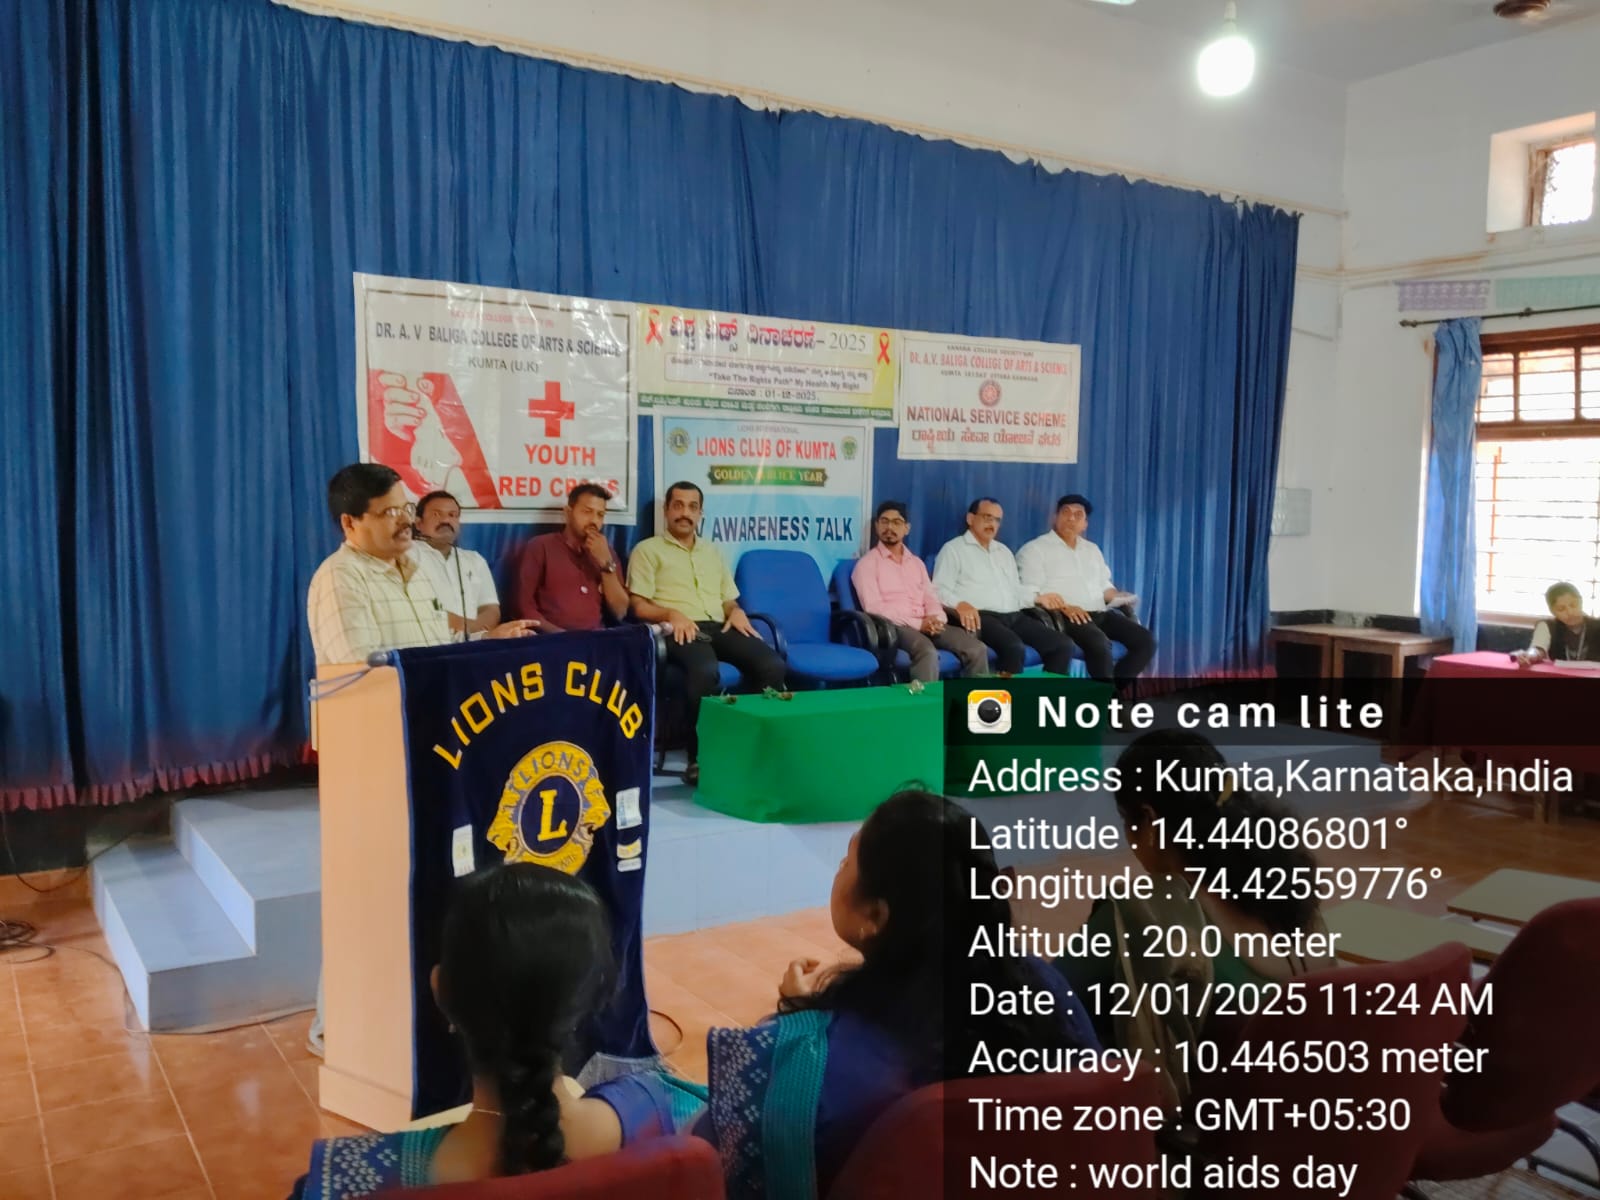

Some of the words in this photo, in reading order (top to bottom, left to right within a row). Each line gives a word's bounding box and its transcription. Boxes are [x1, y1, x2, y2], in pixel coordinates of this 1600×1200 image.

[376, 321, 395, 338] DR.
[399, 322, 411, 340] A.
[413, 324, 422, 341] V
[429, 325, 467, 345] BALIGA
[471, 328, 519, 349] COLLEGE
[521, 333, 536, 350] OF
[538, 335, 565, 353] ARTS
[566, 338, 574, 353] &
[577, 339, 621, 357] SCIENCE
[829, 331, 867, 352] 2025
[468, 356, 508, 370] KUMTA
[941, 353, 968, 368] BALIGA
[970, 354, 1002, 370] COLLEGE
[733, 373, 748, 383] The
[906, 405, 967, 424] NATIONAL
[970, 408, 1021, 426] SERVICE
[1023, 410, 1067, 428] SCHEME
[524, 444, 596, 467] YOUTH
[696, 436, 736, 457] LIONS
[739, 437, 772, 458] CLUB
[775, 439, 792, 458] OF
[795, 440, 837, 461] KUMTA
[499, 475, 541, 497] RED
[549, 476, 620, 498] CRS
[713, 468, 754, 480] GOLDEN
[798, 470, 824, 483] YEAR
[711, 516, 809, 542] AWARENESS
[816, 517, 853, 542] TALK
[433, 662, 545, 770] LIONS
[565, 661, 643, 740] CLUB
[518, 750, 587, 785] LIONS
[537, 789, 568, 842] L
